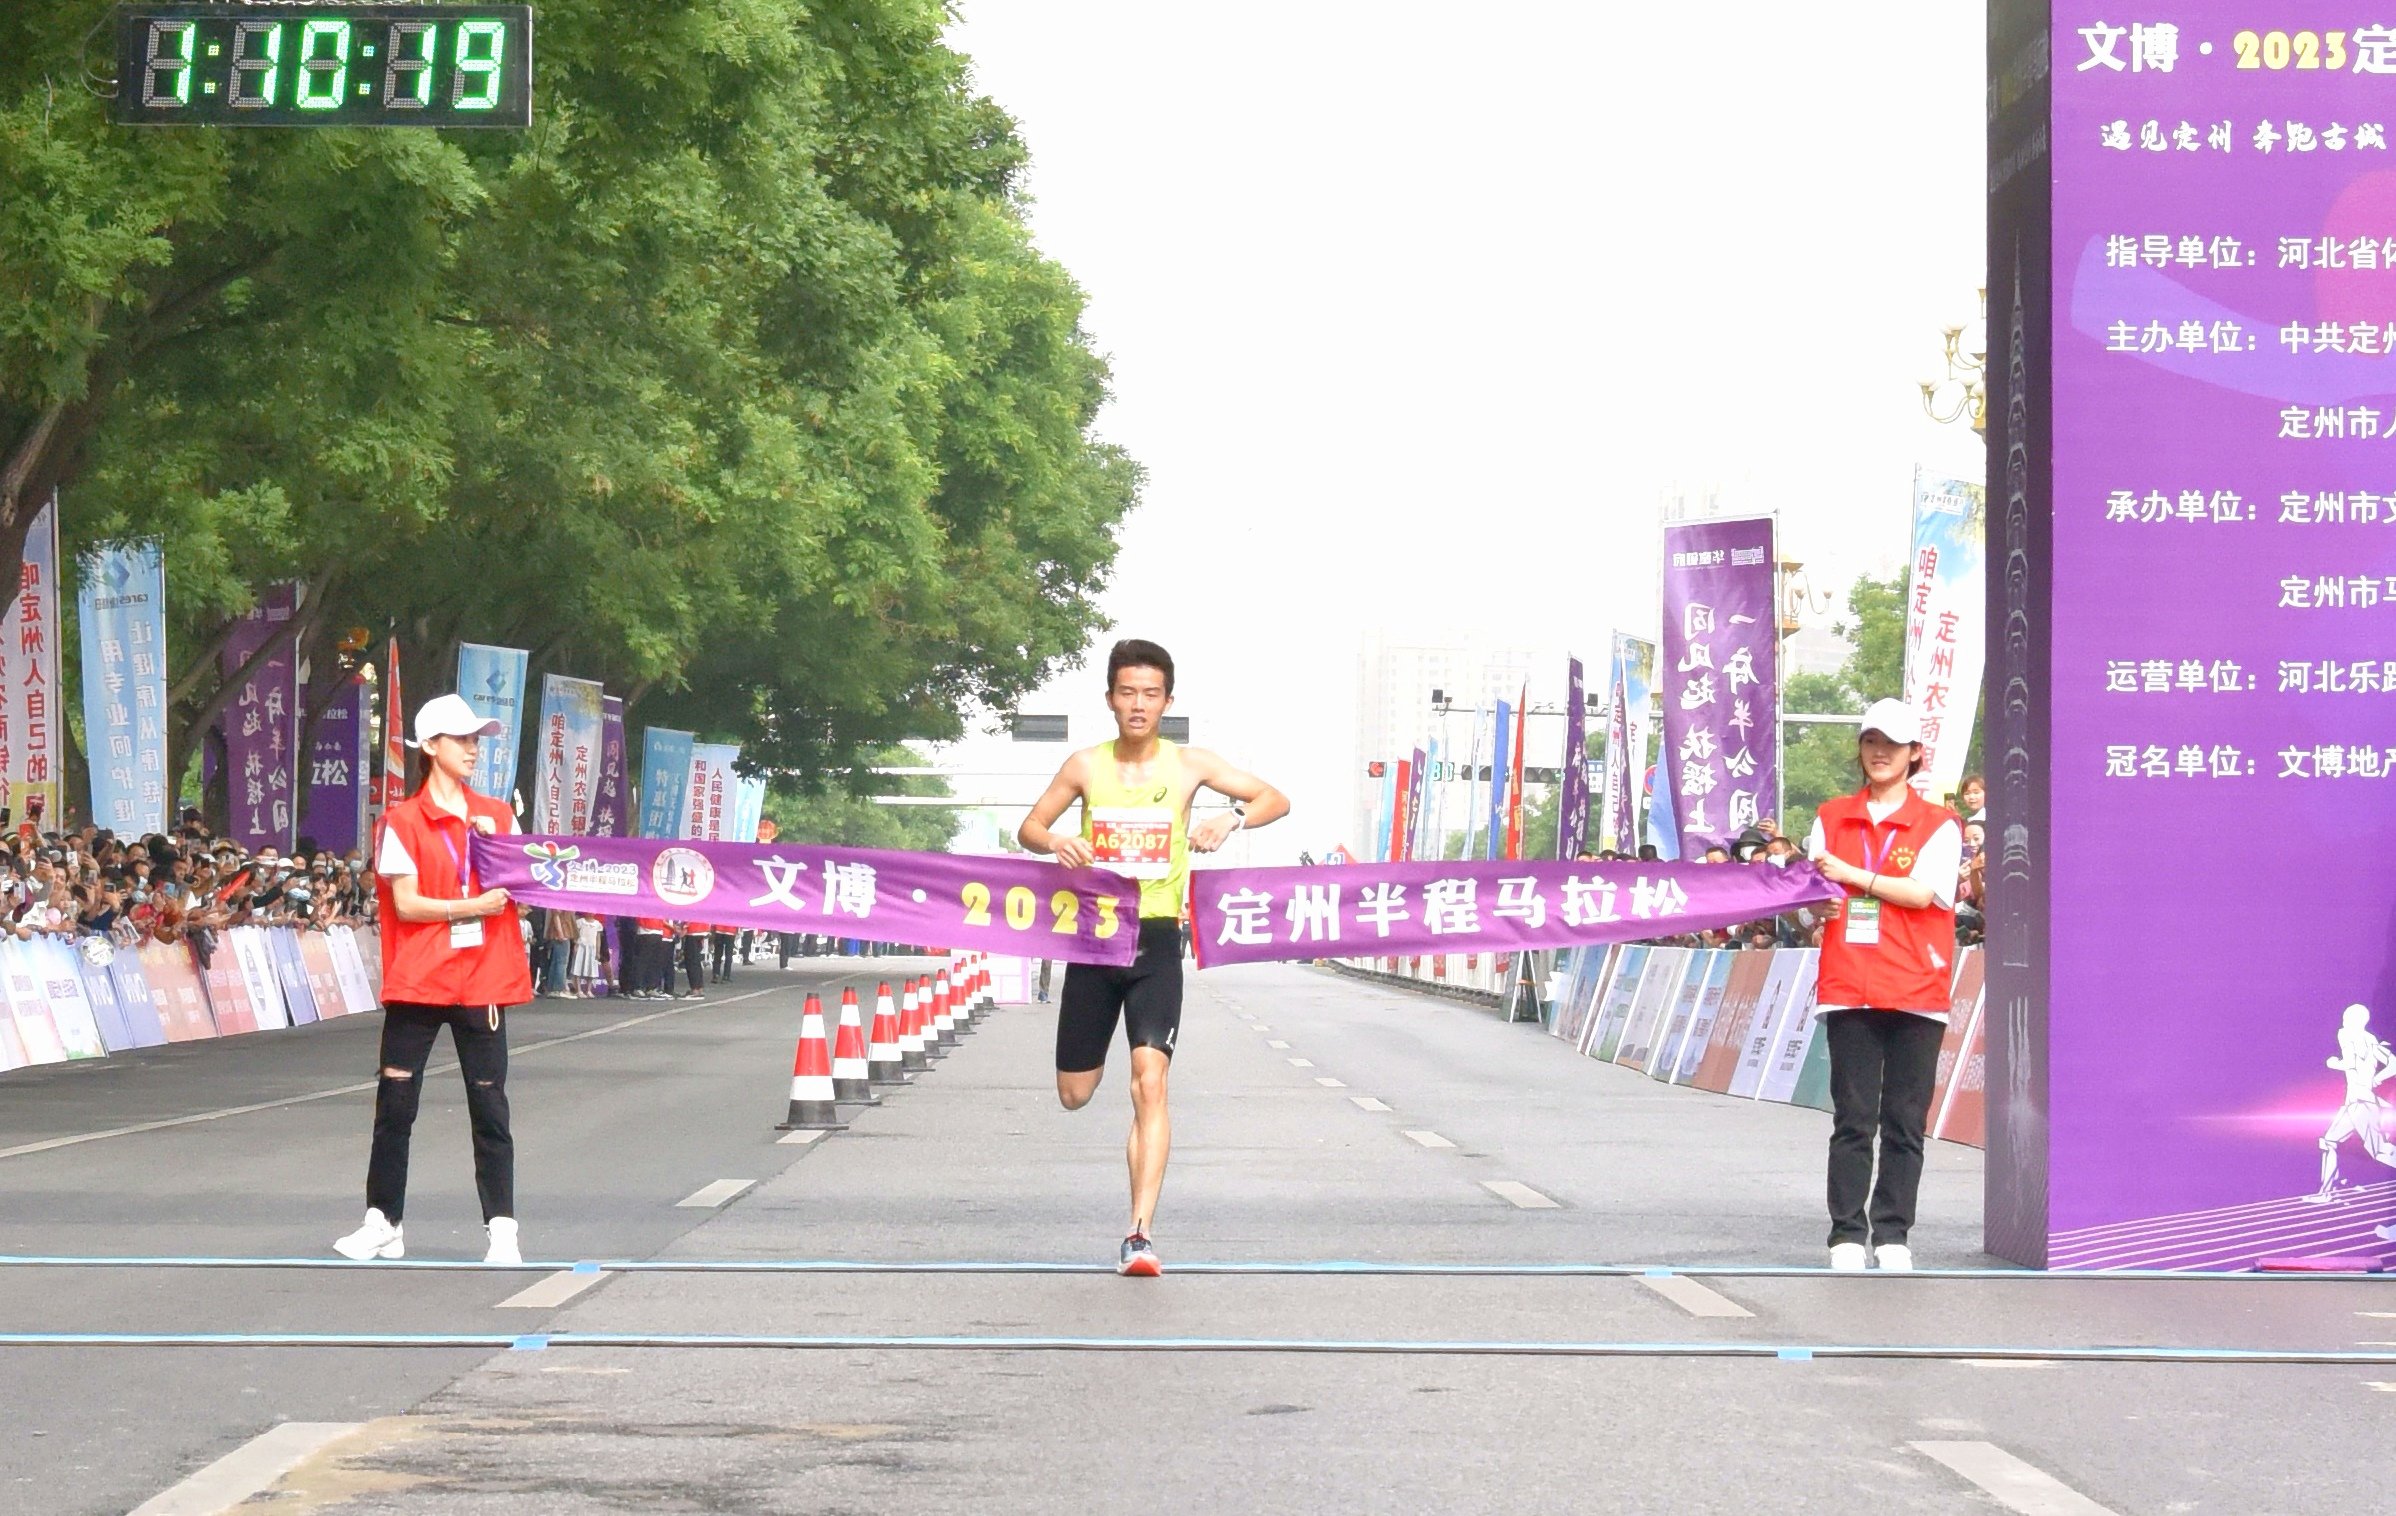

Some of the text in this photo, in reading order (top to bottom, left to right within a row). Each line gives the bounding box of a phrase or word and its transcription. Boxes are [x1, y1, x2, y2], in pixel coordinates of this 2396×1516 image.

[174, 18, 506, 110] 1:10:19
[2100, 118, 2387, 154] 遇见定州 奔跑古城
[1096, 833, 1169, 850] A62087
[1217, 875, 1689, 946] 定州半程马拉松
